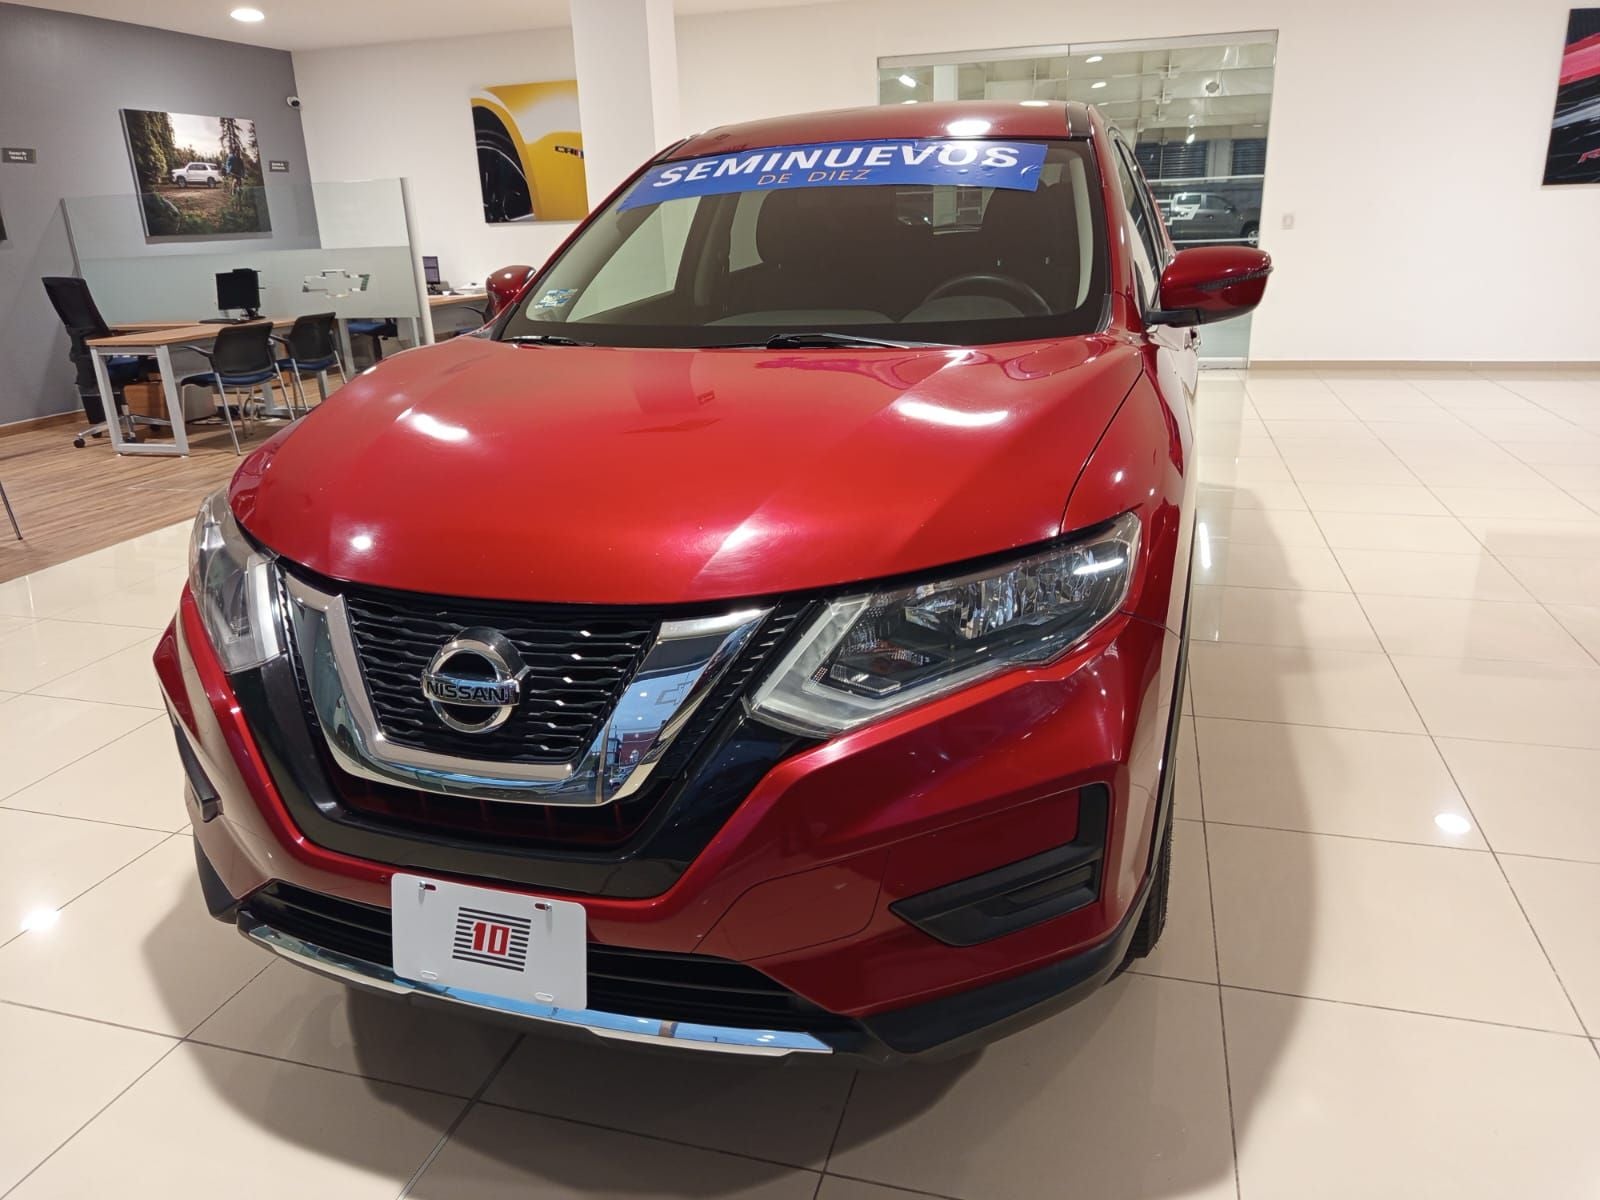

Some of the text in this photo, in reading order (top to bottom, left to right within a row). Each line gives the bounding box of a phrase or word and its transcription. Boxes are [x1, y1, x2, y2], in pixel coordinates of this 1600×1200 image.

[652, 145, 1020, 187] SEMINUEVOS
[757, 168, 873, 185] DE DIEZ
[426, 681, 505, 701] NISSAN
[473, 921, 510, 956] 10
